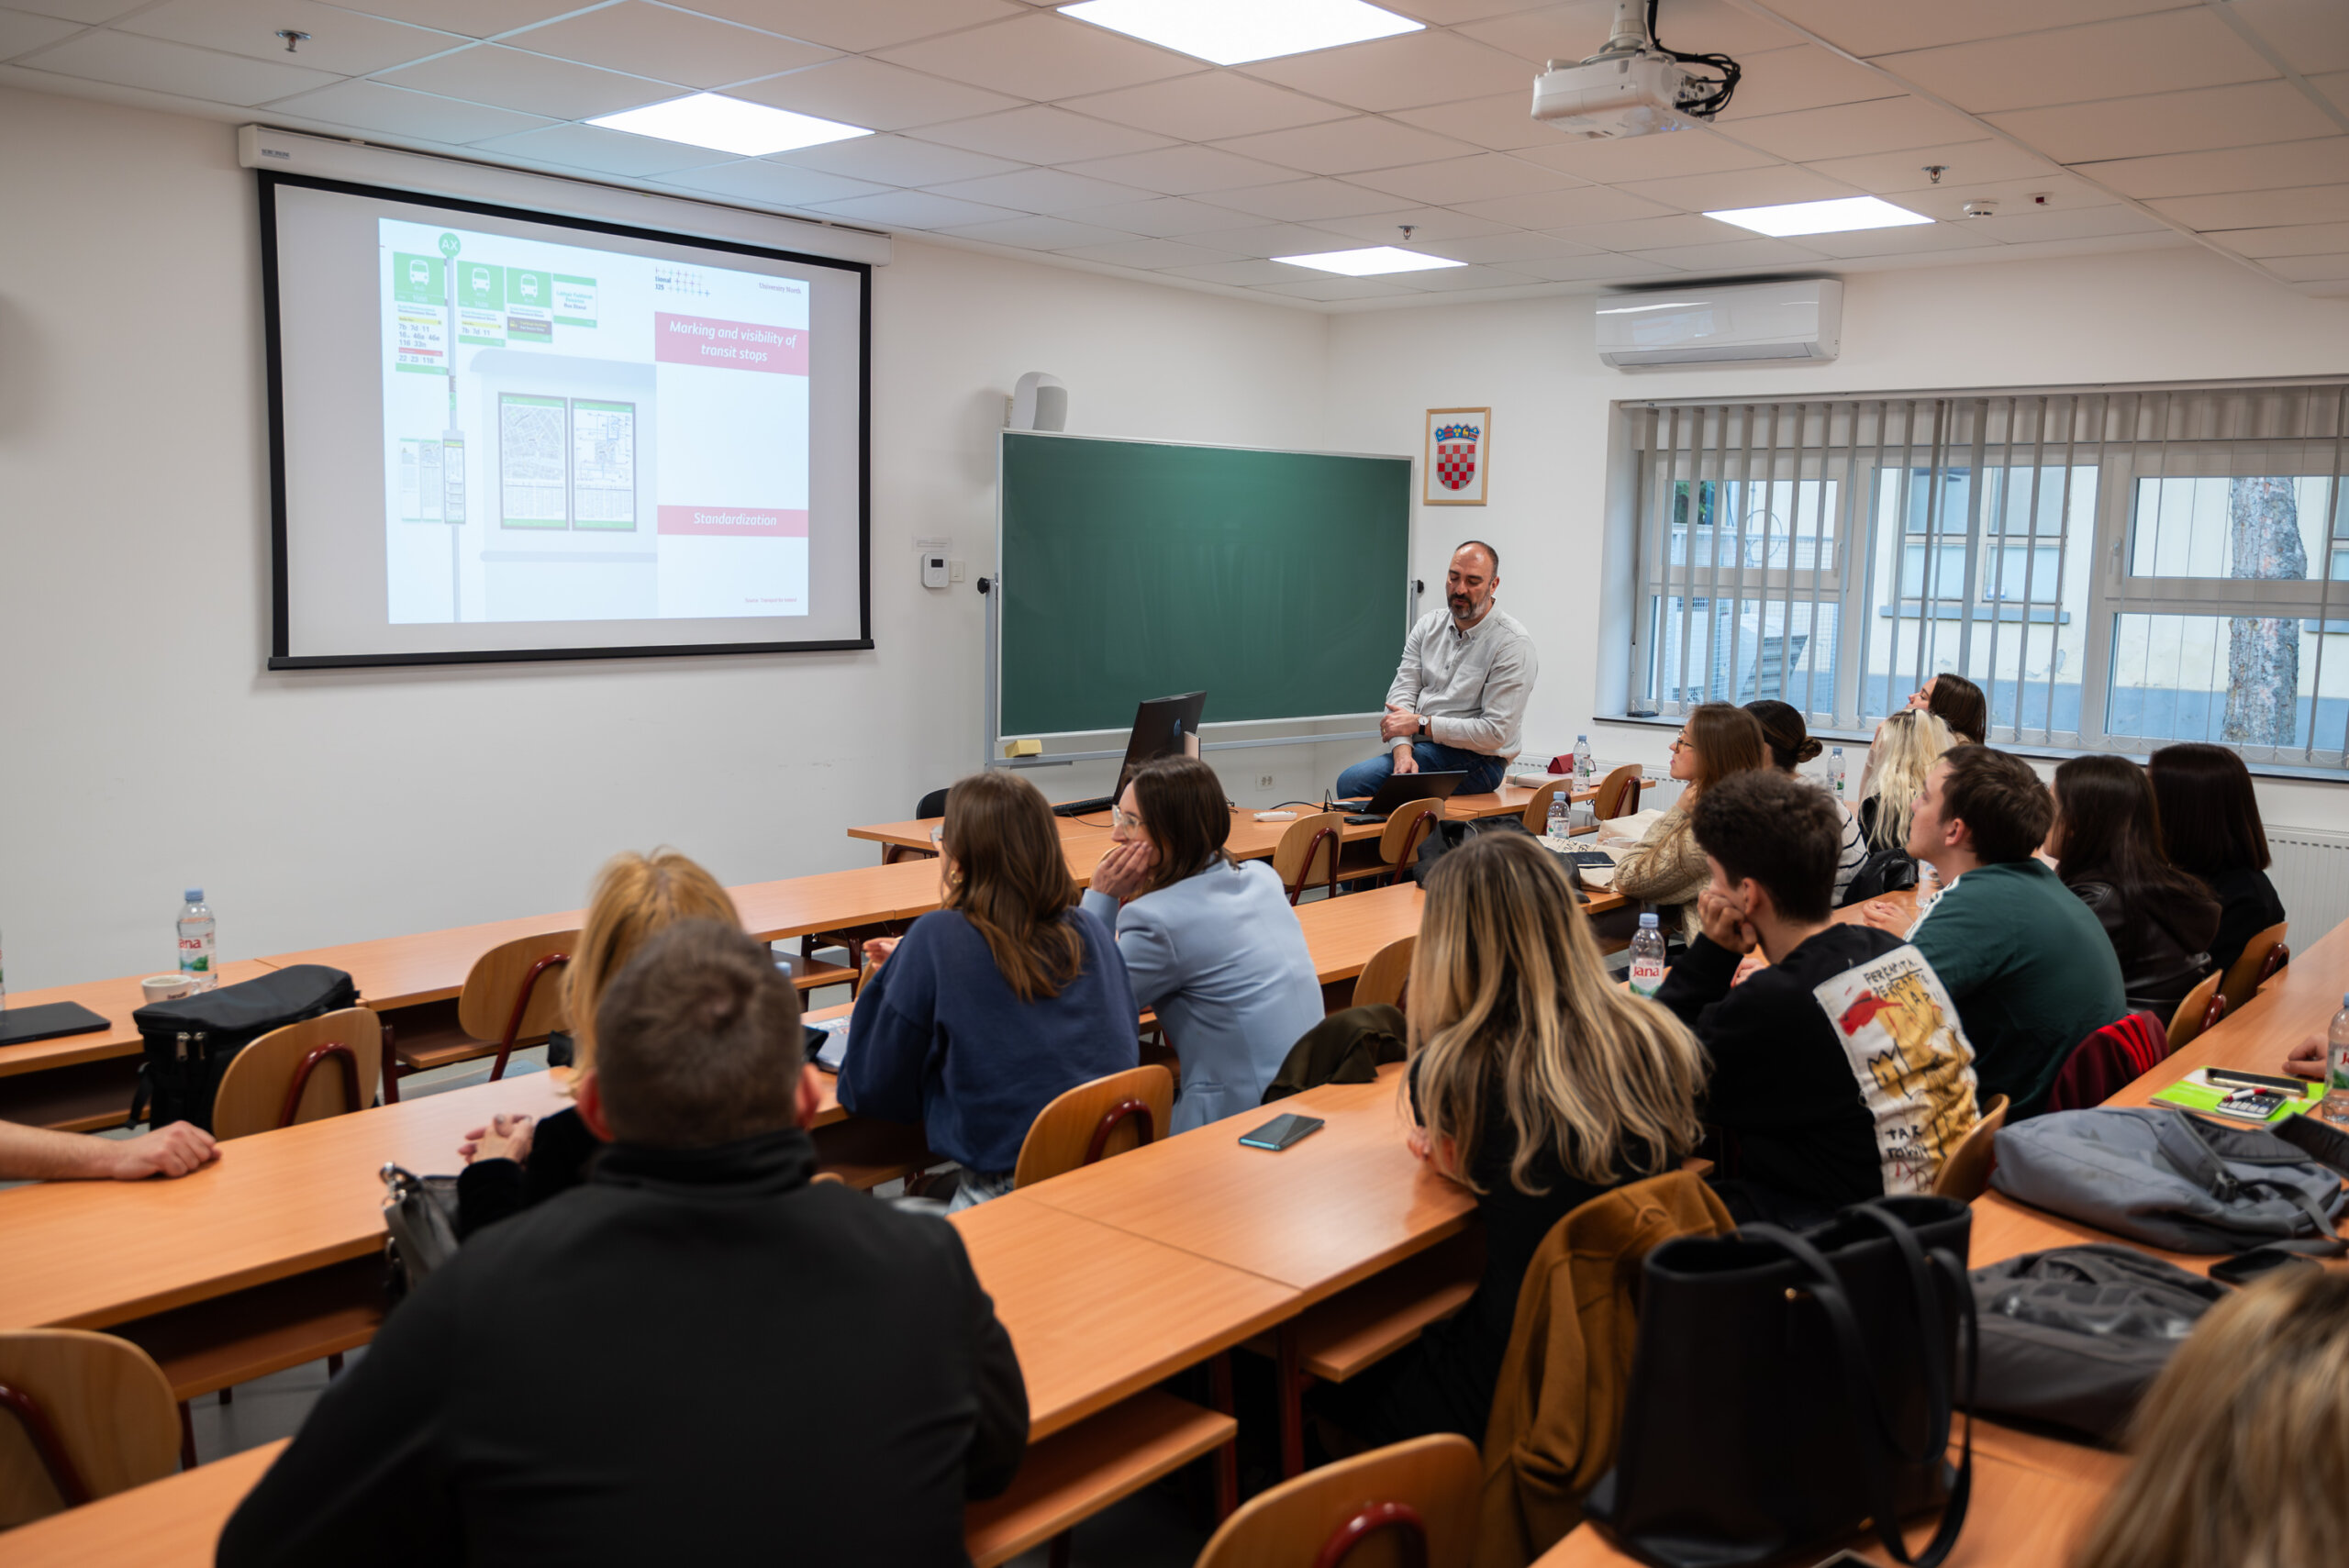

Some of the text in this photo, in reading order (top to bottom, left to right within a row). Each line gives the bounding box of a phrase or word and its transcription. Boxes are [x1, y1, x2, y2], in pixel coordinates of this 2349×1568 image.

[441, 239, 460, 251] AX
[759, 282, 802, 295] University North
[670, 320, 797, 350] Marking and visibility of
[701, 343, 768, 363] transit stops
[694, 512, 777, 526] Standardization
[179, 939, 201, 949] ana
[1633, 965, 1660, 977] Jana
